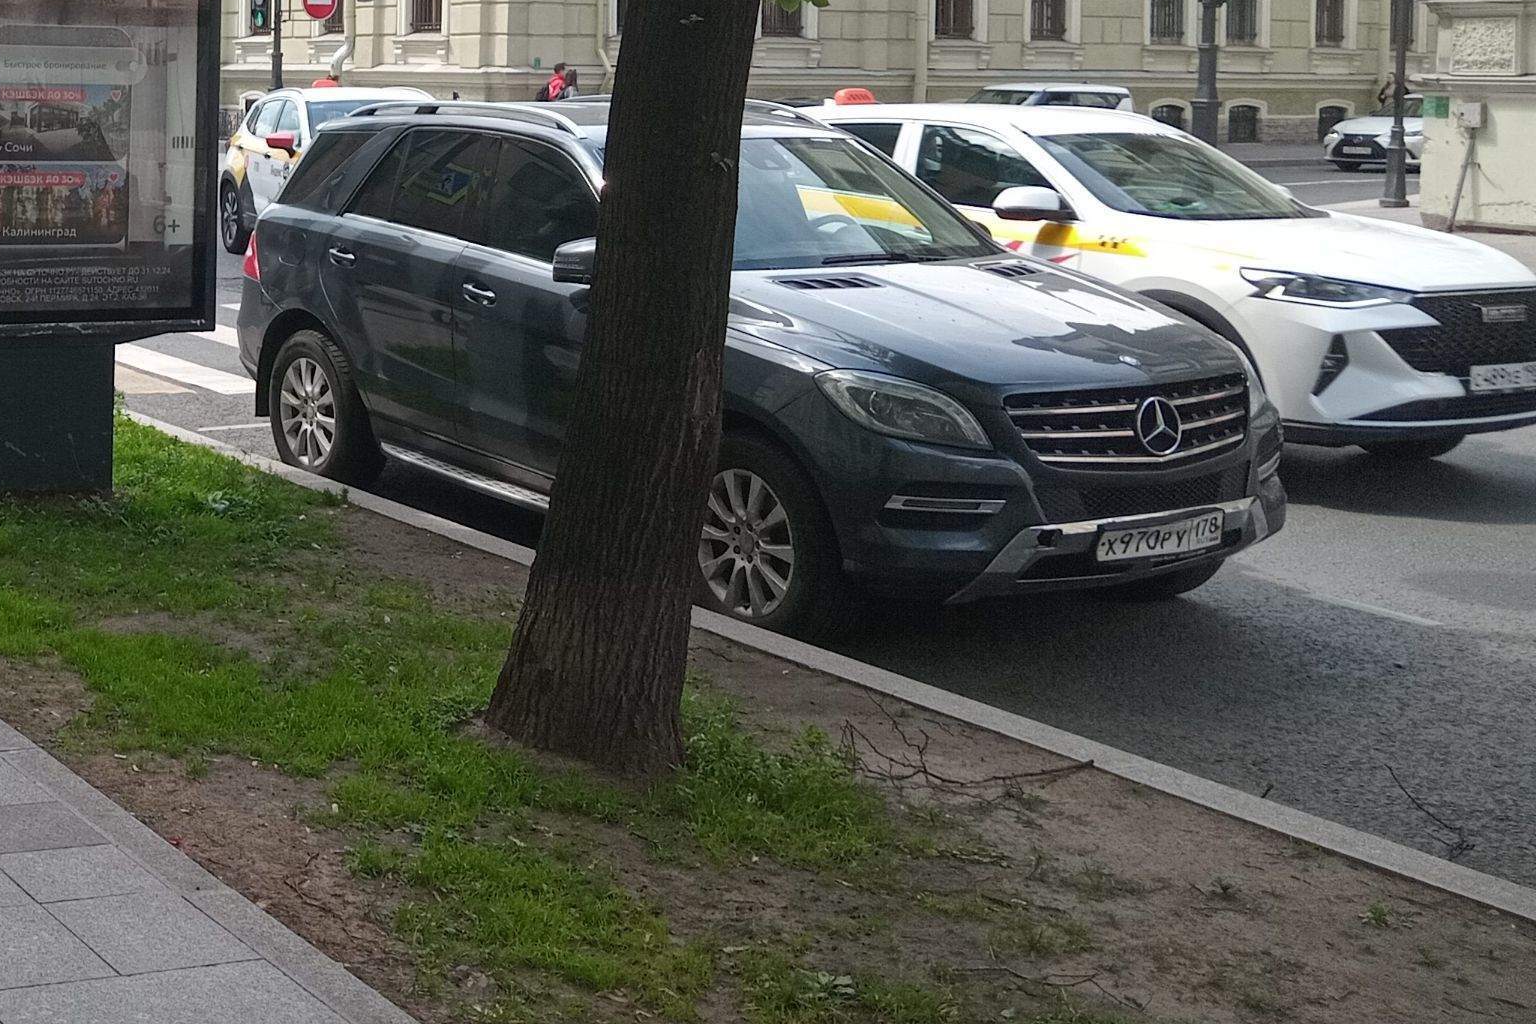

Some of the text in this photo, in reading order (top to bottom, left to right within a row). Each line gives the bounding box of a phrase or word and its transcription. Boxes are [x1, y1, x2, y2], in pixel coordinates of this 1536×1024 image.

[1, 91, 45, 100] КЭШБЭК
[47, 92, 61, 100] ДО
[4, 143, 33, 153] Сочи
[0, 175, 43, 184] КЭШБЭК
[45, 175, 59, 184] ДО
[153, 215, 180, 234] 6+
[1, 228, 77, 240] Калининград
